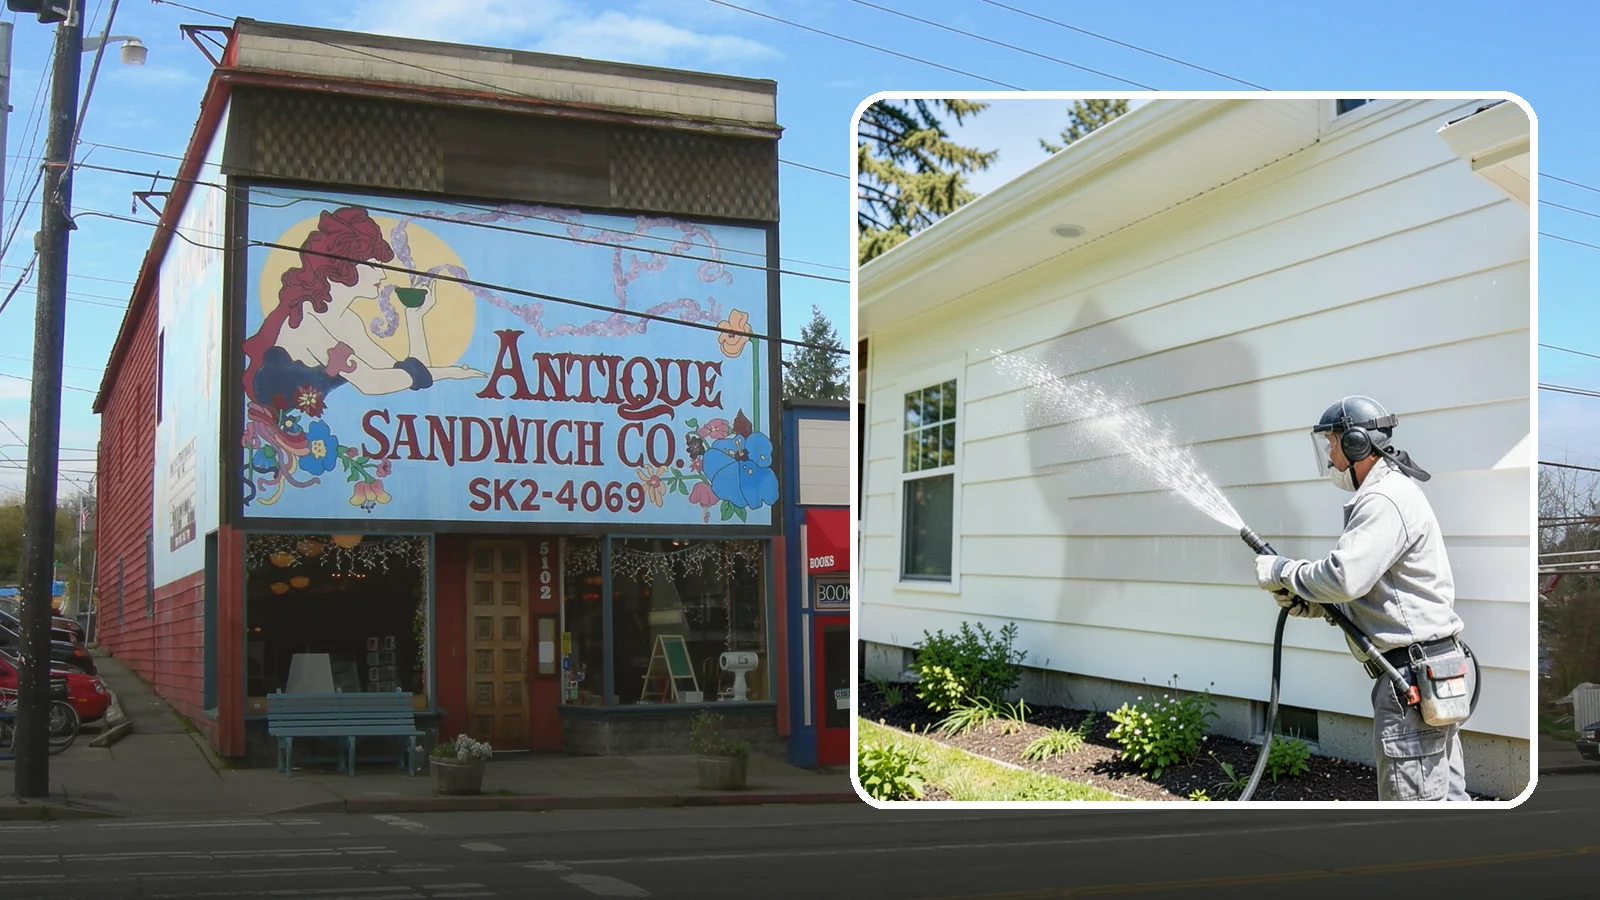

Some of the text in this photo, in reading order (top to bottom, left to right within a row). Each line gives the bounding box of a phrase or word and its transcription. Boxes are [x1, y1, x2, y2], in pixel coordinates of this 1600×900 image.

[476, 329, 723, 421] ANTIQUE
[361, 408, 684, 469] SANDWICH CO.
[469, 477, 645, 513] SK2-4069
[540, 541, 552, 600] 5102
[809, 555, 835, 569] BOOKS
